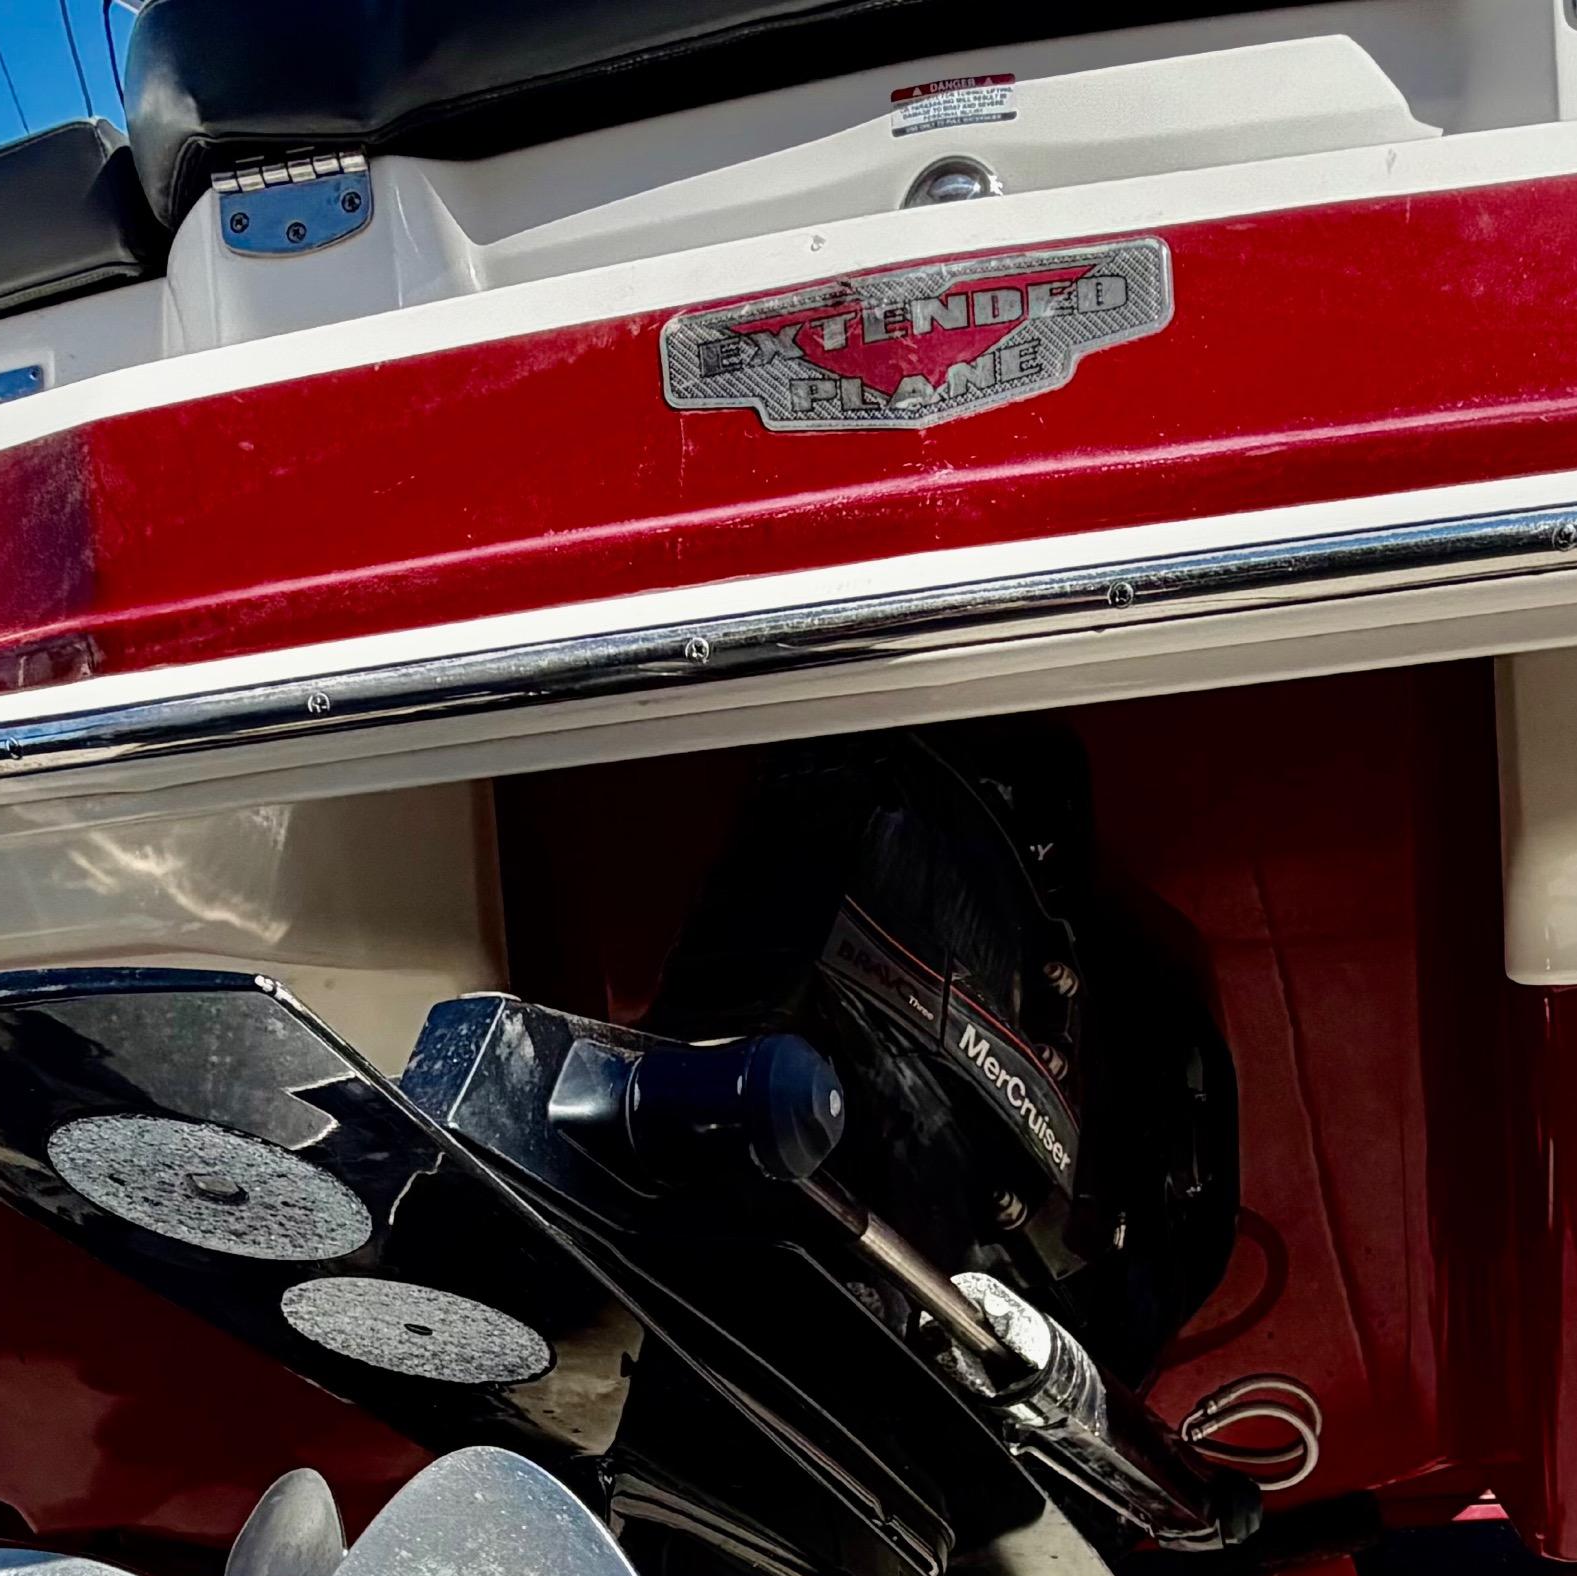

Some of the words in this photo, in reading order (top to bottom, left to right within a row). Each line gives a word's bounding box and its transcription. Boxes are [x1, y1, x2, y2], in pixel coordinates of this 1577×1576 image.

[930, 79, 975, 92] DANGER
[697, 275, 1127, 378] EXTENDED
[790, 339, 1043, 411] PLANE
[908, 994, 935, 1021] Three
[957, 1022, 1072, 1171] MerCruiser
